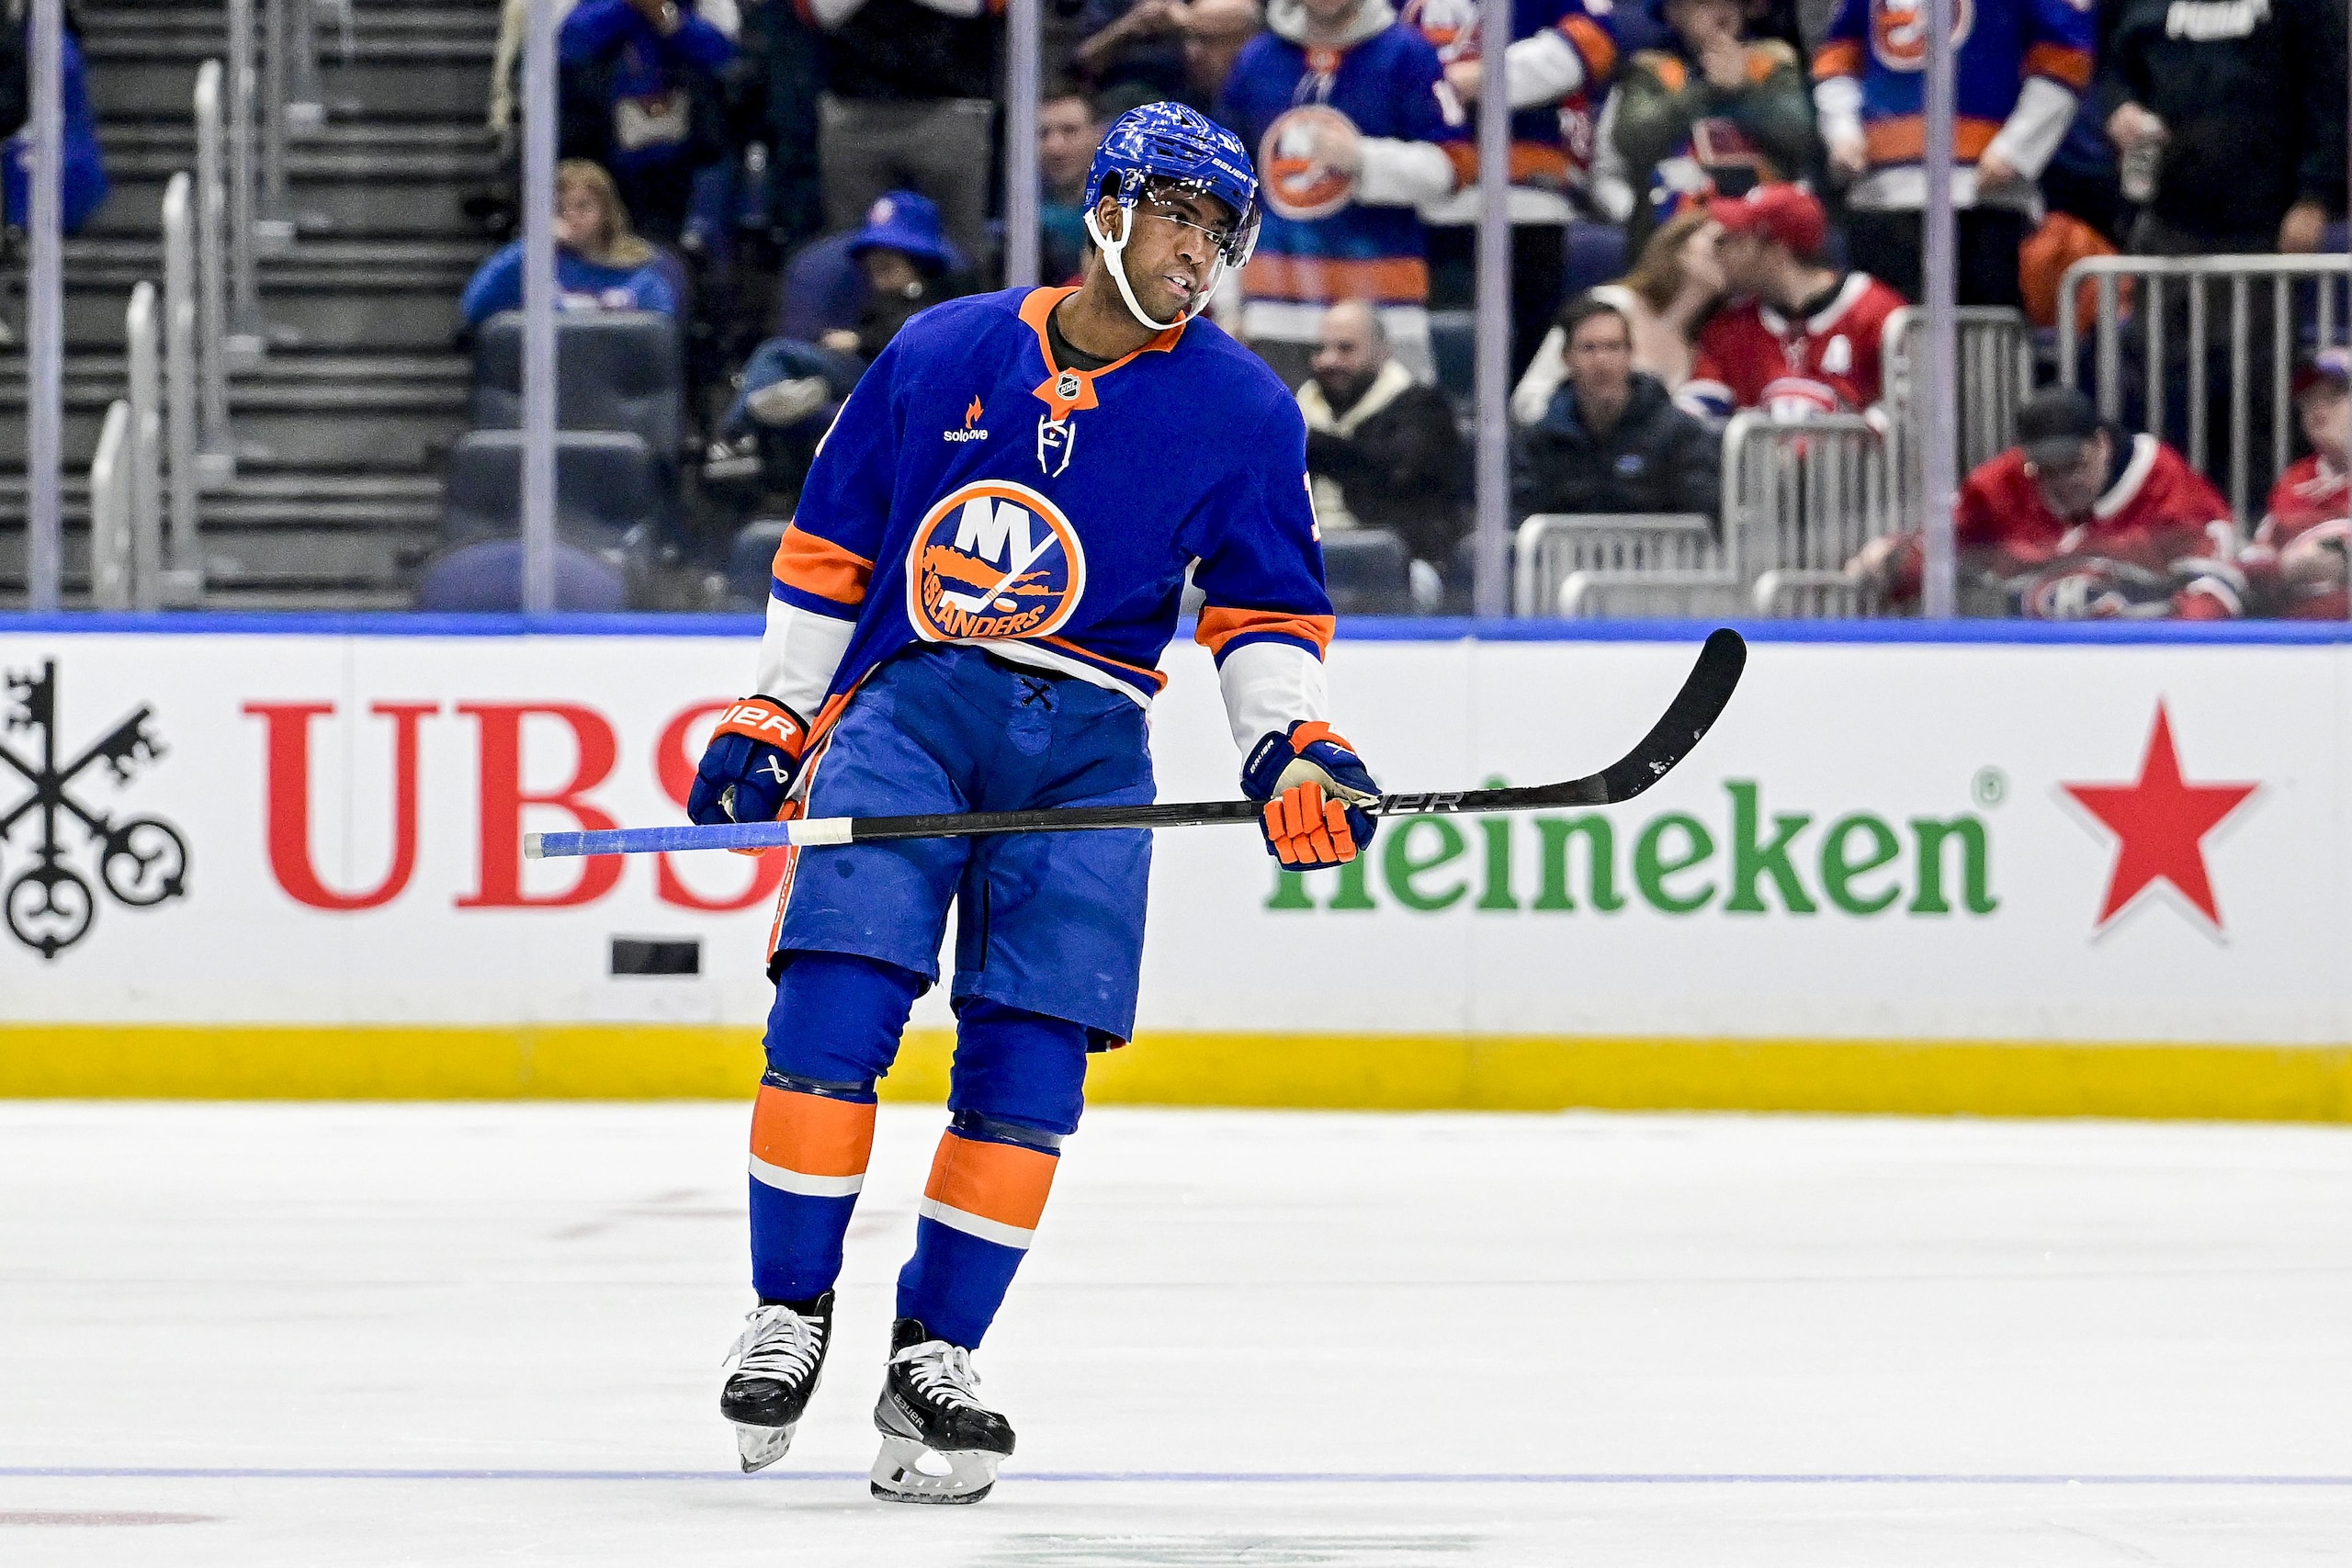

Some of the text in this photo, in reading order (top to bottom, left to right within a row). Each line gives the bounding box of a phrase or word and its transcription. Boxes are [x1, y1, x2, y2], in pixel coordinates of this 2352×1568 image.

[924, 571, 1046, 637] ISLANDERS
[242, 701, 790, 912] UBS
[893, 1393, 925, 1428] BAUER
